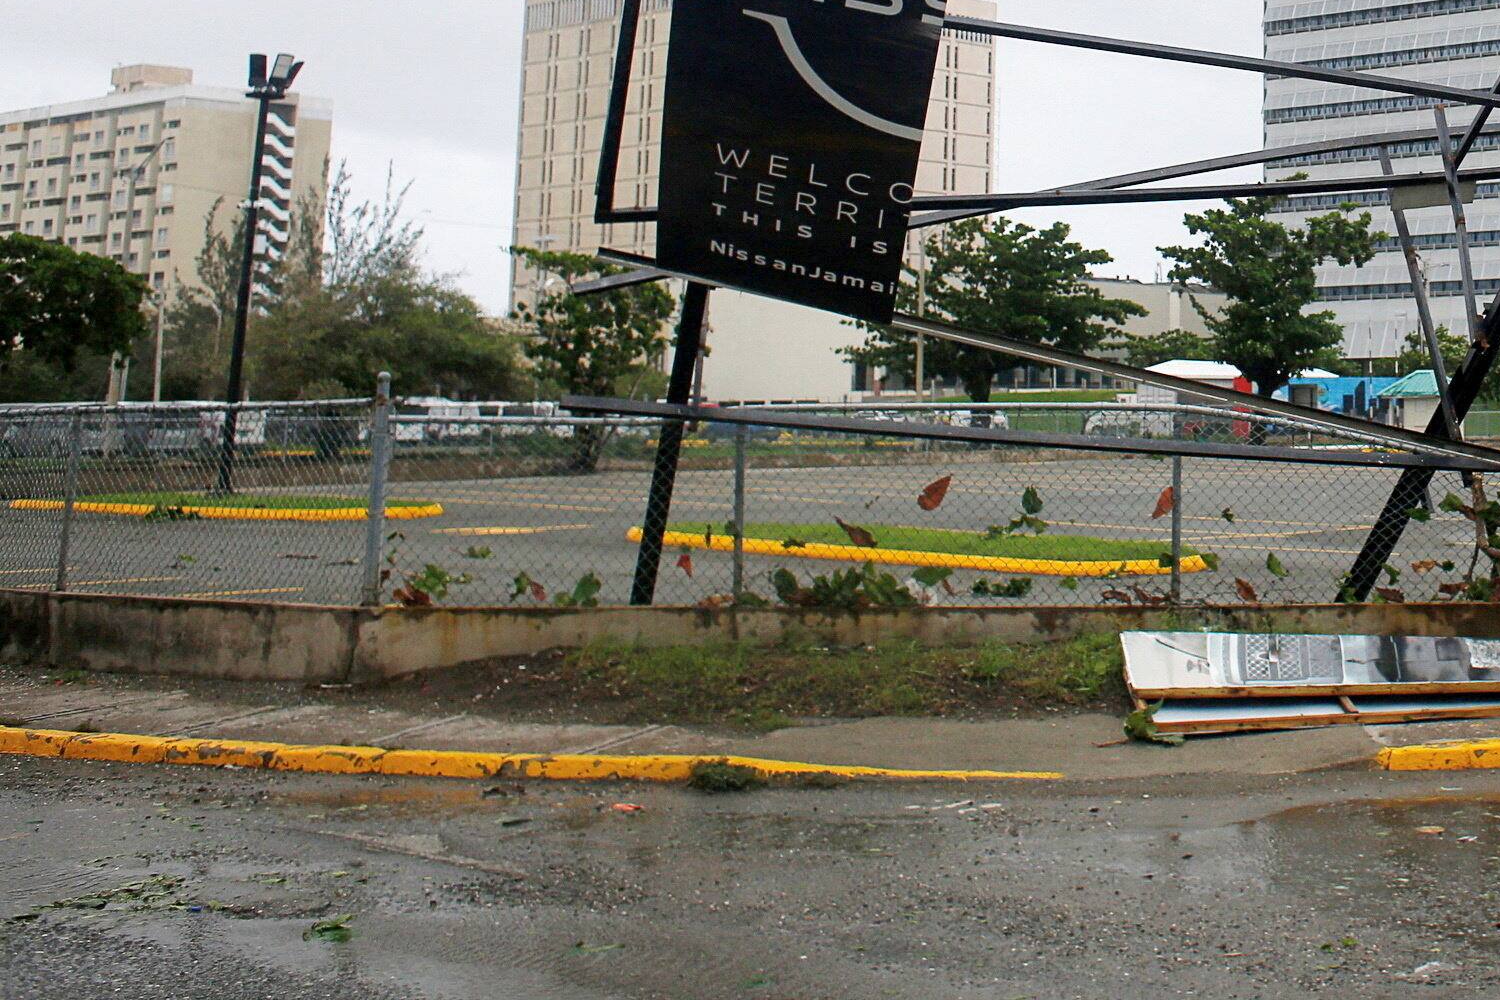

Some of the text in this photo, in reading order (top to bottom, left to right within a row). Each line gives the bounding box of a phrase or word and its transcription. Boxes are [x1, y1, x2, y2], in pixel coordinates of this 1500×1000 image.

[714, 171, 909, 229] TERRI
[716, 142, 914, 204] WELCO
[711, 203, 888, 255] THIS IS
